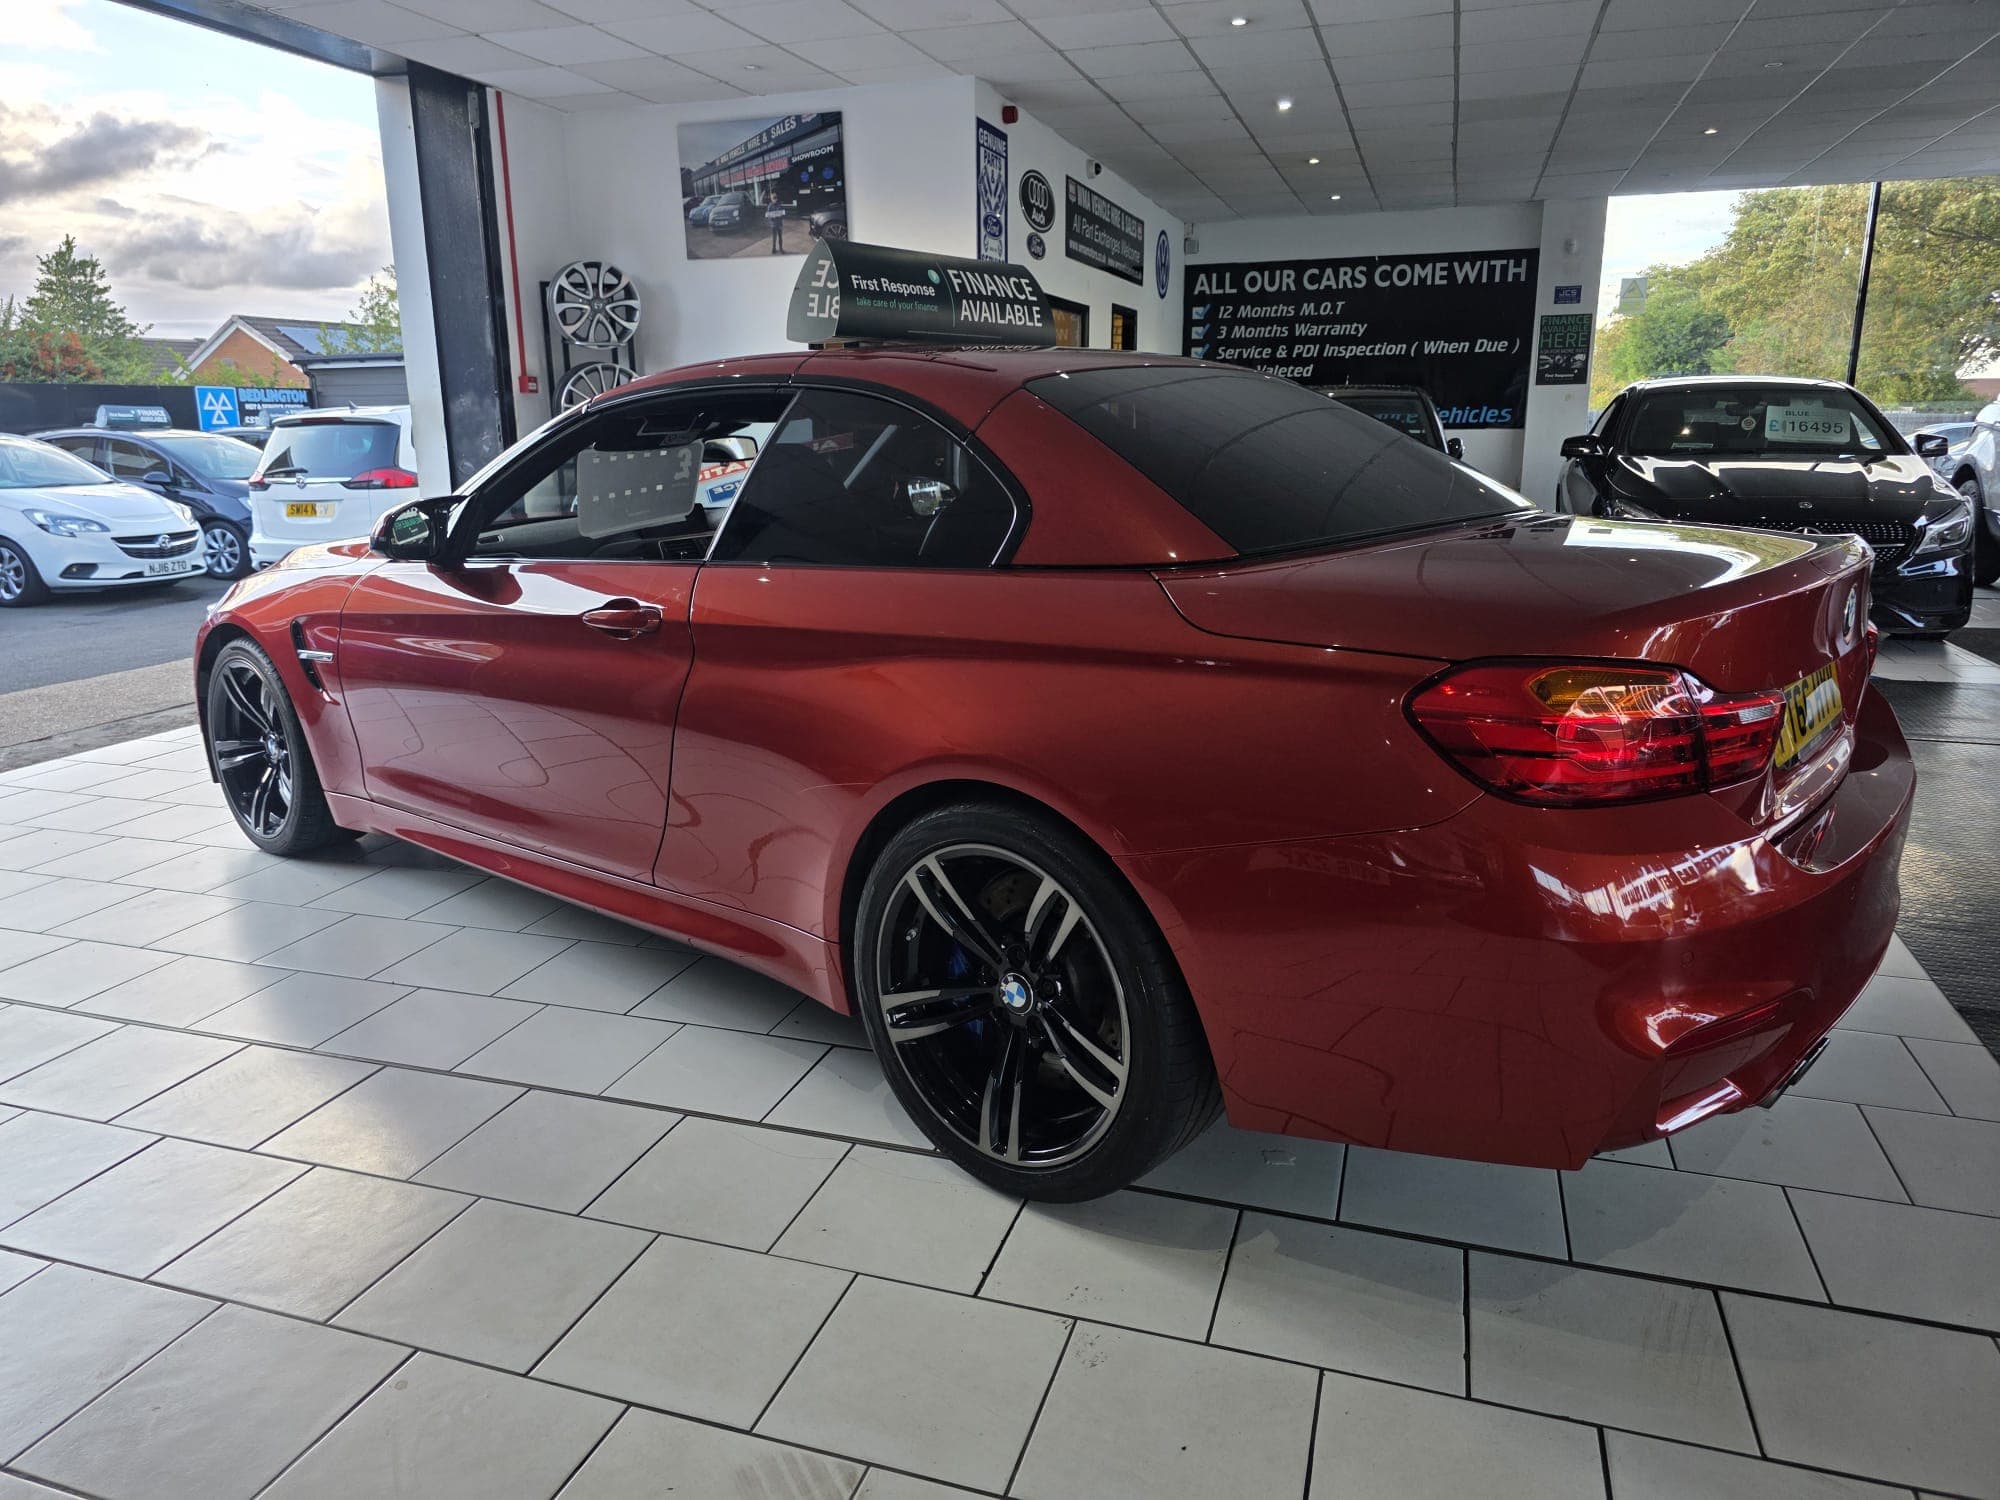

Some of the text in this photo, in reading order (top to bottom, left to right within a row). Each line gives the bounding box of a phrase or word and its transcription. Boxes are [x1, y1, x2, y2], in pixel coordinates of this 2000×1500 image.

[748, 137, 761, 150] HIRE
[762, 133, 768, 143] &
[771, 116, 797, 139] SALES
[979, 127, 1007, 156] GENUINE
[791, 145, 834, 163] SHOWROOM
[984, 150, 1002, 169] PARTS
[1031, 207, 1046, 225] Audi
[986, 217, 1001, 237] Ford
[1072, 213, 1081, 233] All
[1081, 217, 1094, 241] Part
[1094, 224, 1121, 256] Exchanges
[1031, 235, 1043, 254] Ford
[851, 275, 936, 296] First Response
[947, 269, 1037, 301] FINANCE
[1193, 259, 1527, 295] ALL OUR CARS COME WITH
[857, 297, 938, 312] take care of your finance
[961, 299, 1042, 327] AVAILABLE
[1218, 301, 1345, 319] 12 Months M.O.T
[1541, 325, 1588, 333] AVAILABLE
[1542, 315, 1590, 325] FINANCE
[1217, 322, 1367, 339] 3 Months Warranty
[1216, 345, 1272, 360] Service
[1276, 345, 1287, 358] &
[1292, 344, 1320, 358] PDI
[1323, 342, 1406, 359] Inspection
[1424, 340, 1470, 355] When
[1474, 338, 1508, 353] Due
[1540, 333, 1588, 348] HERE
[238, 388, 308, 402] BEDLINGTON
[1436, 406, 1512, 424] ehicles
[1769, 420, 1843, 434] £ 16495
[149, 562, 169, 574] NJ16
